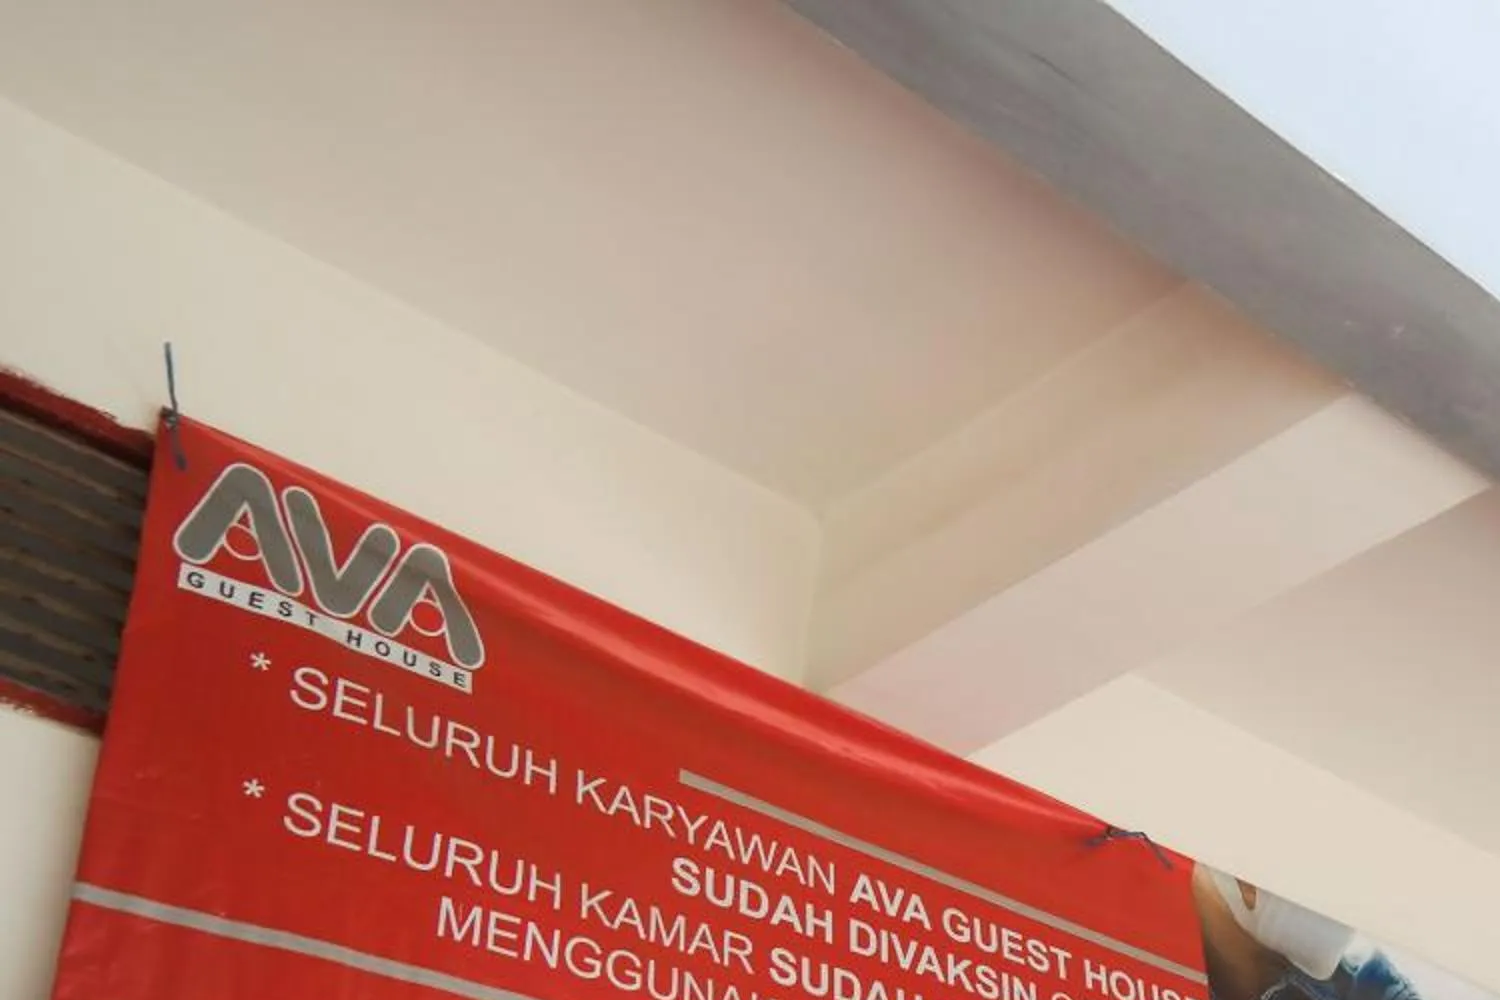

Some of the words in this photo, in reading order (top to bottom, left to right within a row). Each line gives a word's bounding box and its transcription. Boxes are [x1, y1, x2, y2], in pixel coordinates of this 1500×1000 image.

[173, 463, 486, 669] AVA
[187, 571, 318, 626] GUEST
[347, 629, 465, 688] HOUSE
[283, 791, 562, 910] SELURUH
[581, 883, 755, 975] KAMAR
[290, 666, 558, 794] SELURUH
[575, 770, 835, 895] KARYAWAN
[850, 874, 932, 930] AVA
[943, 910, 1070, 980] GUEST
[671, 857, 834, 944] SUDAH
